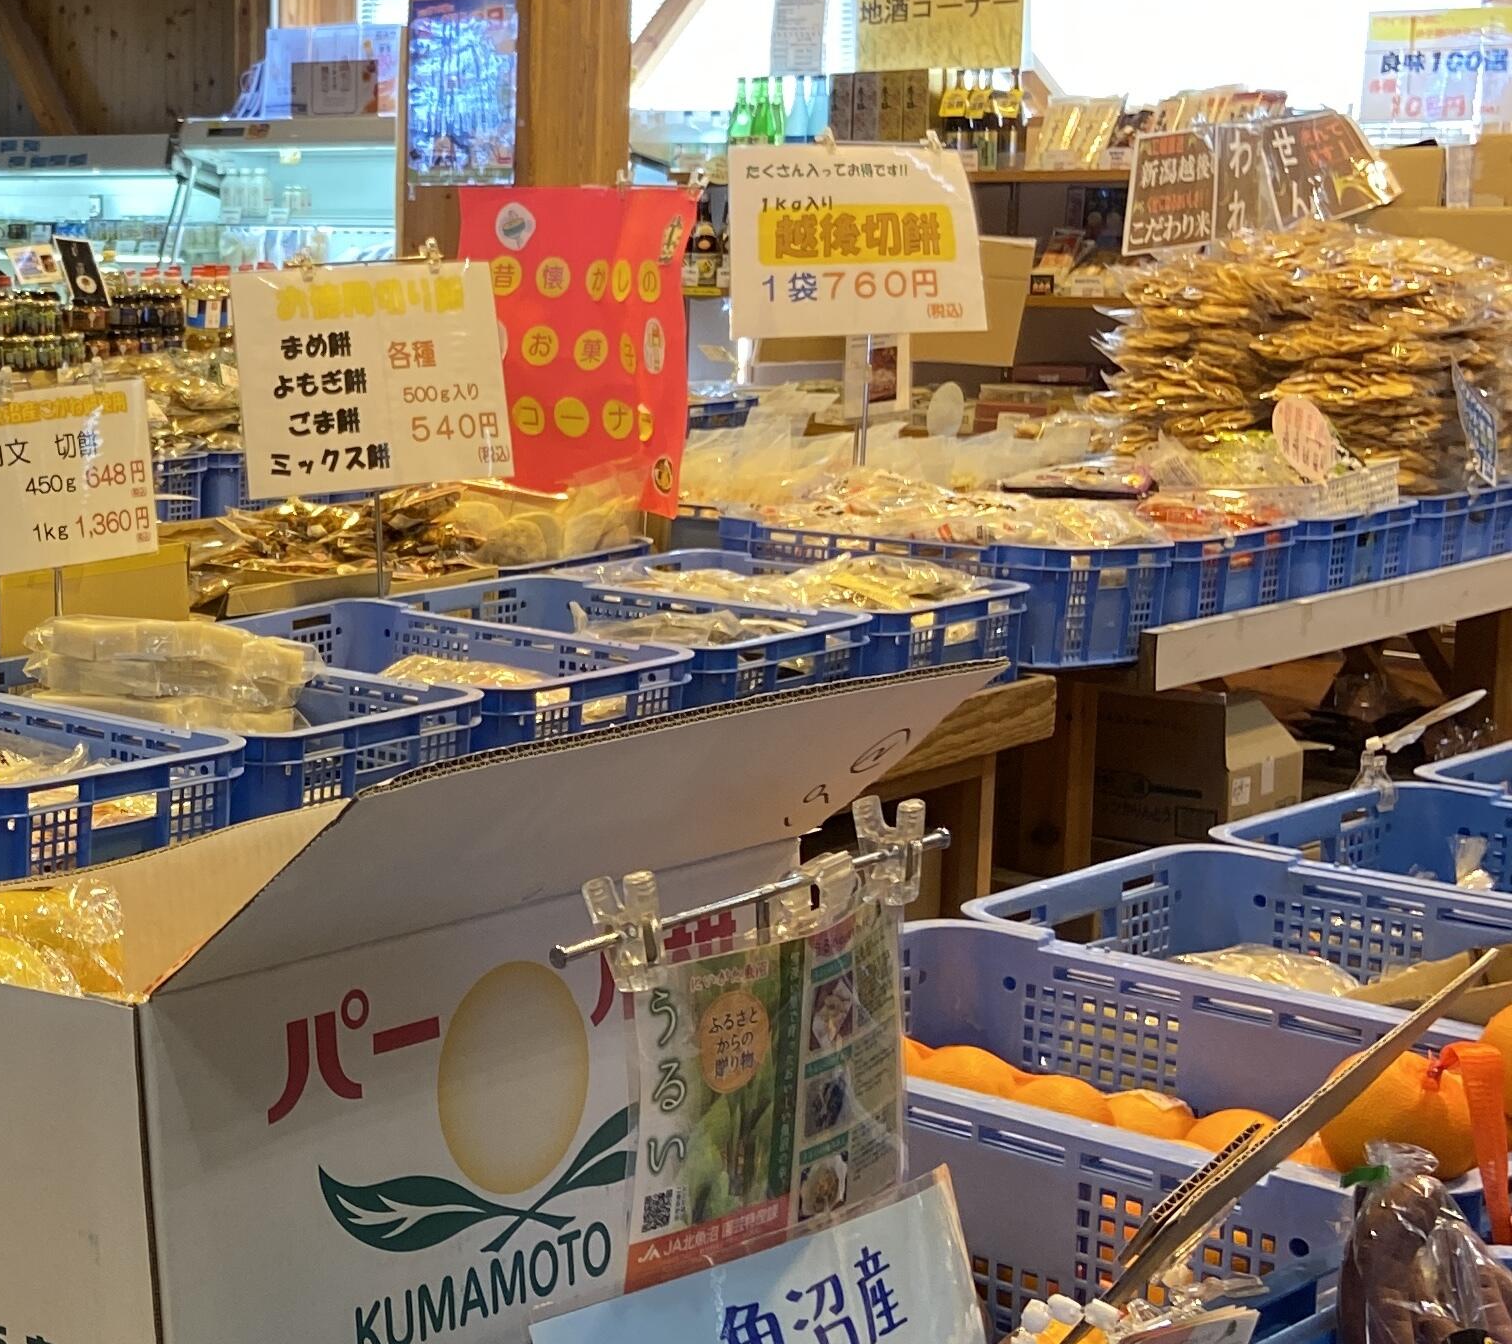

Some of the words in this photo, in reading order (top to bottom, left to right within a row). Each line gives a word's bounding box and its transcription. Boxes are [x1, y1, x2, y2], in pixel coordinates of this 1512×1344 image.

[762, 196, 833, 213] 1kg入り
[775, 212, 941, 259] 越後切餅
[1129, 212, 1211, 245] こだわり米
[927, 303, 963, 319] (税込)
[280, 331, 352, 360] まめ餅
[388, 340, 436, 369] 各種
[273, 367, 367, 399] よもぎ餅
[403, 383, 479, 403] 500g入り
[289, 407, 360, 436] ごま餅
[411, 412, 499, 442] 540円
[271, 443, 390, 476] ミックス餅
[25, 474, 76, 495] 450g
[86, 459, 145, 489] 648円
[33, 523, 69, 542] 1kg
[75, 506, 150, 539] 1,360円
[709, 1006, 759, 1034] ふるさと
[716, 1031, 754, 1054] からの
[648, 989, 688, 1176] うるい
